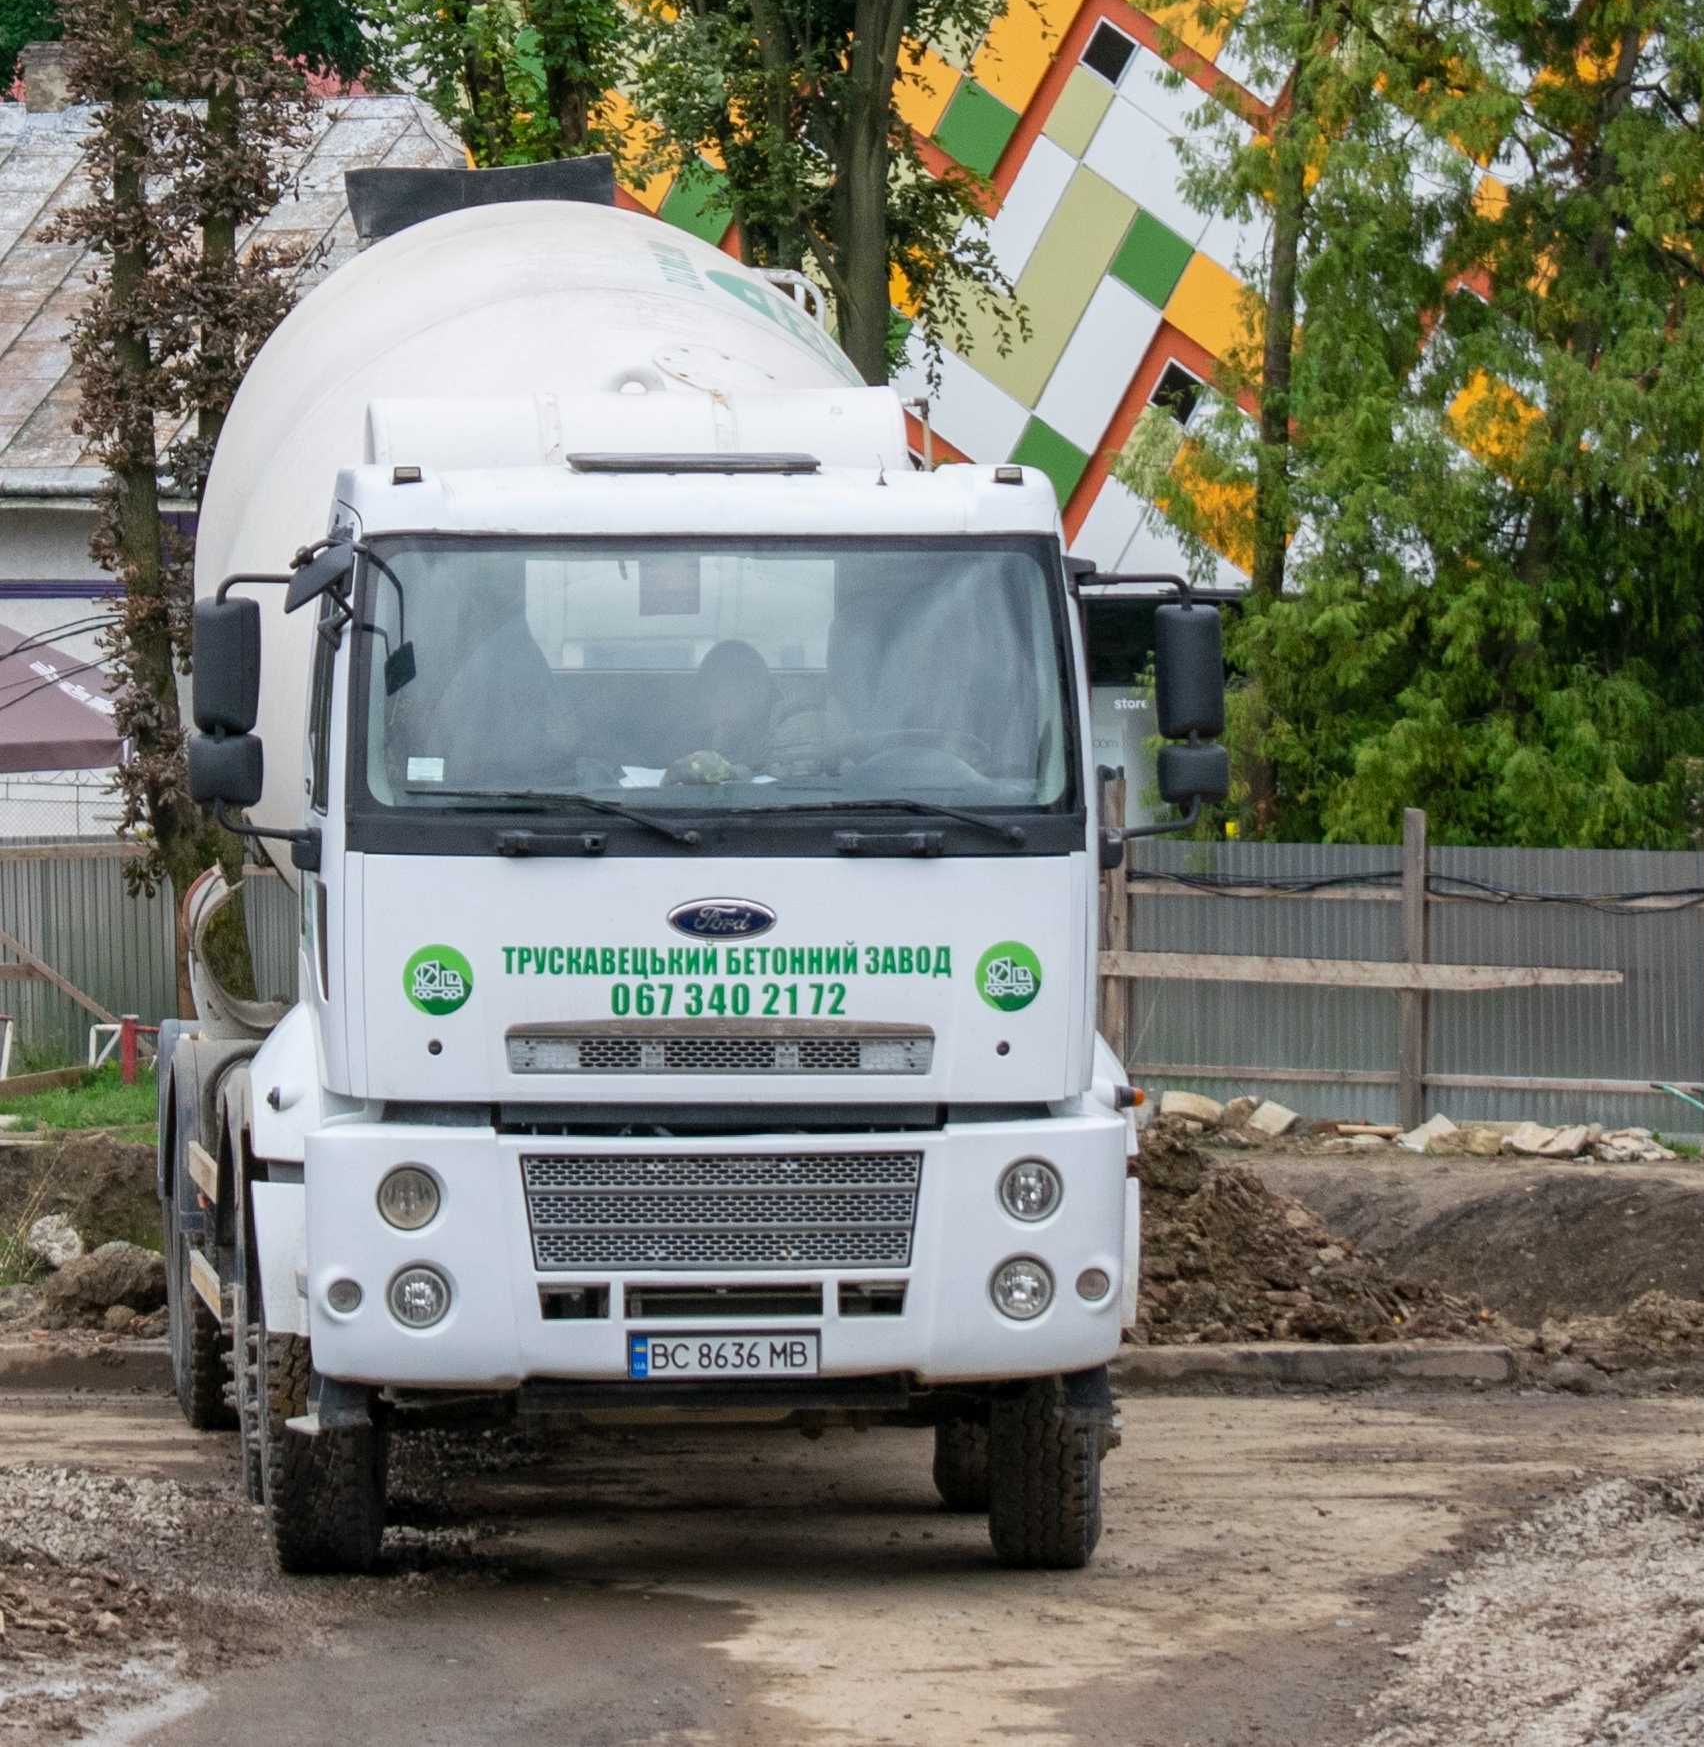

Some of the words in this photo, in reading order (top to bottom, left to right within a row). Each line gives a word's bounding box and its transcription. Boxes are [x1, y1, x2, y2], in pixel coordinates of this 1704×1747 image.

[694, 906, 751, 930] Ford
[502, 940, 718, 979] ТРУСКАВЕЦЬКИЙ
[724, 940, 858, 975] БЕТОННИЙ
[864, 945, 953, 979] ЗАВОД
[611, 983, 675, 1017] 067
[684, 983, 751, 1017] 340
[651, 1343, 690, 1370] BC
[698, 1342, 761, 1369] 8636
[769, 1341, 808, 1368] MB
